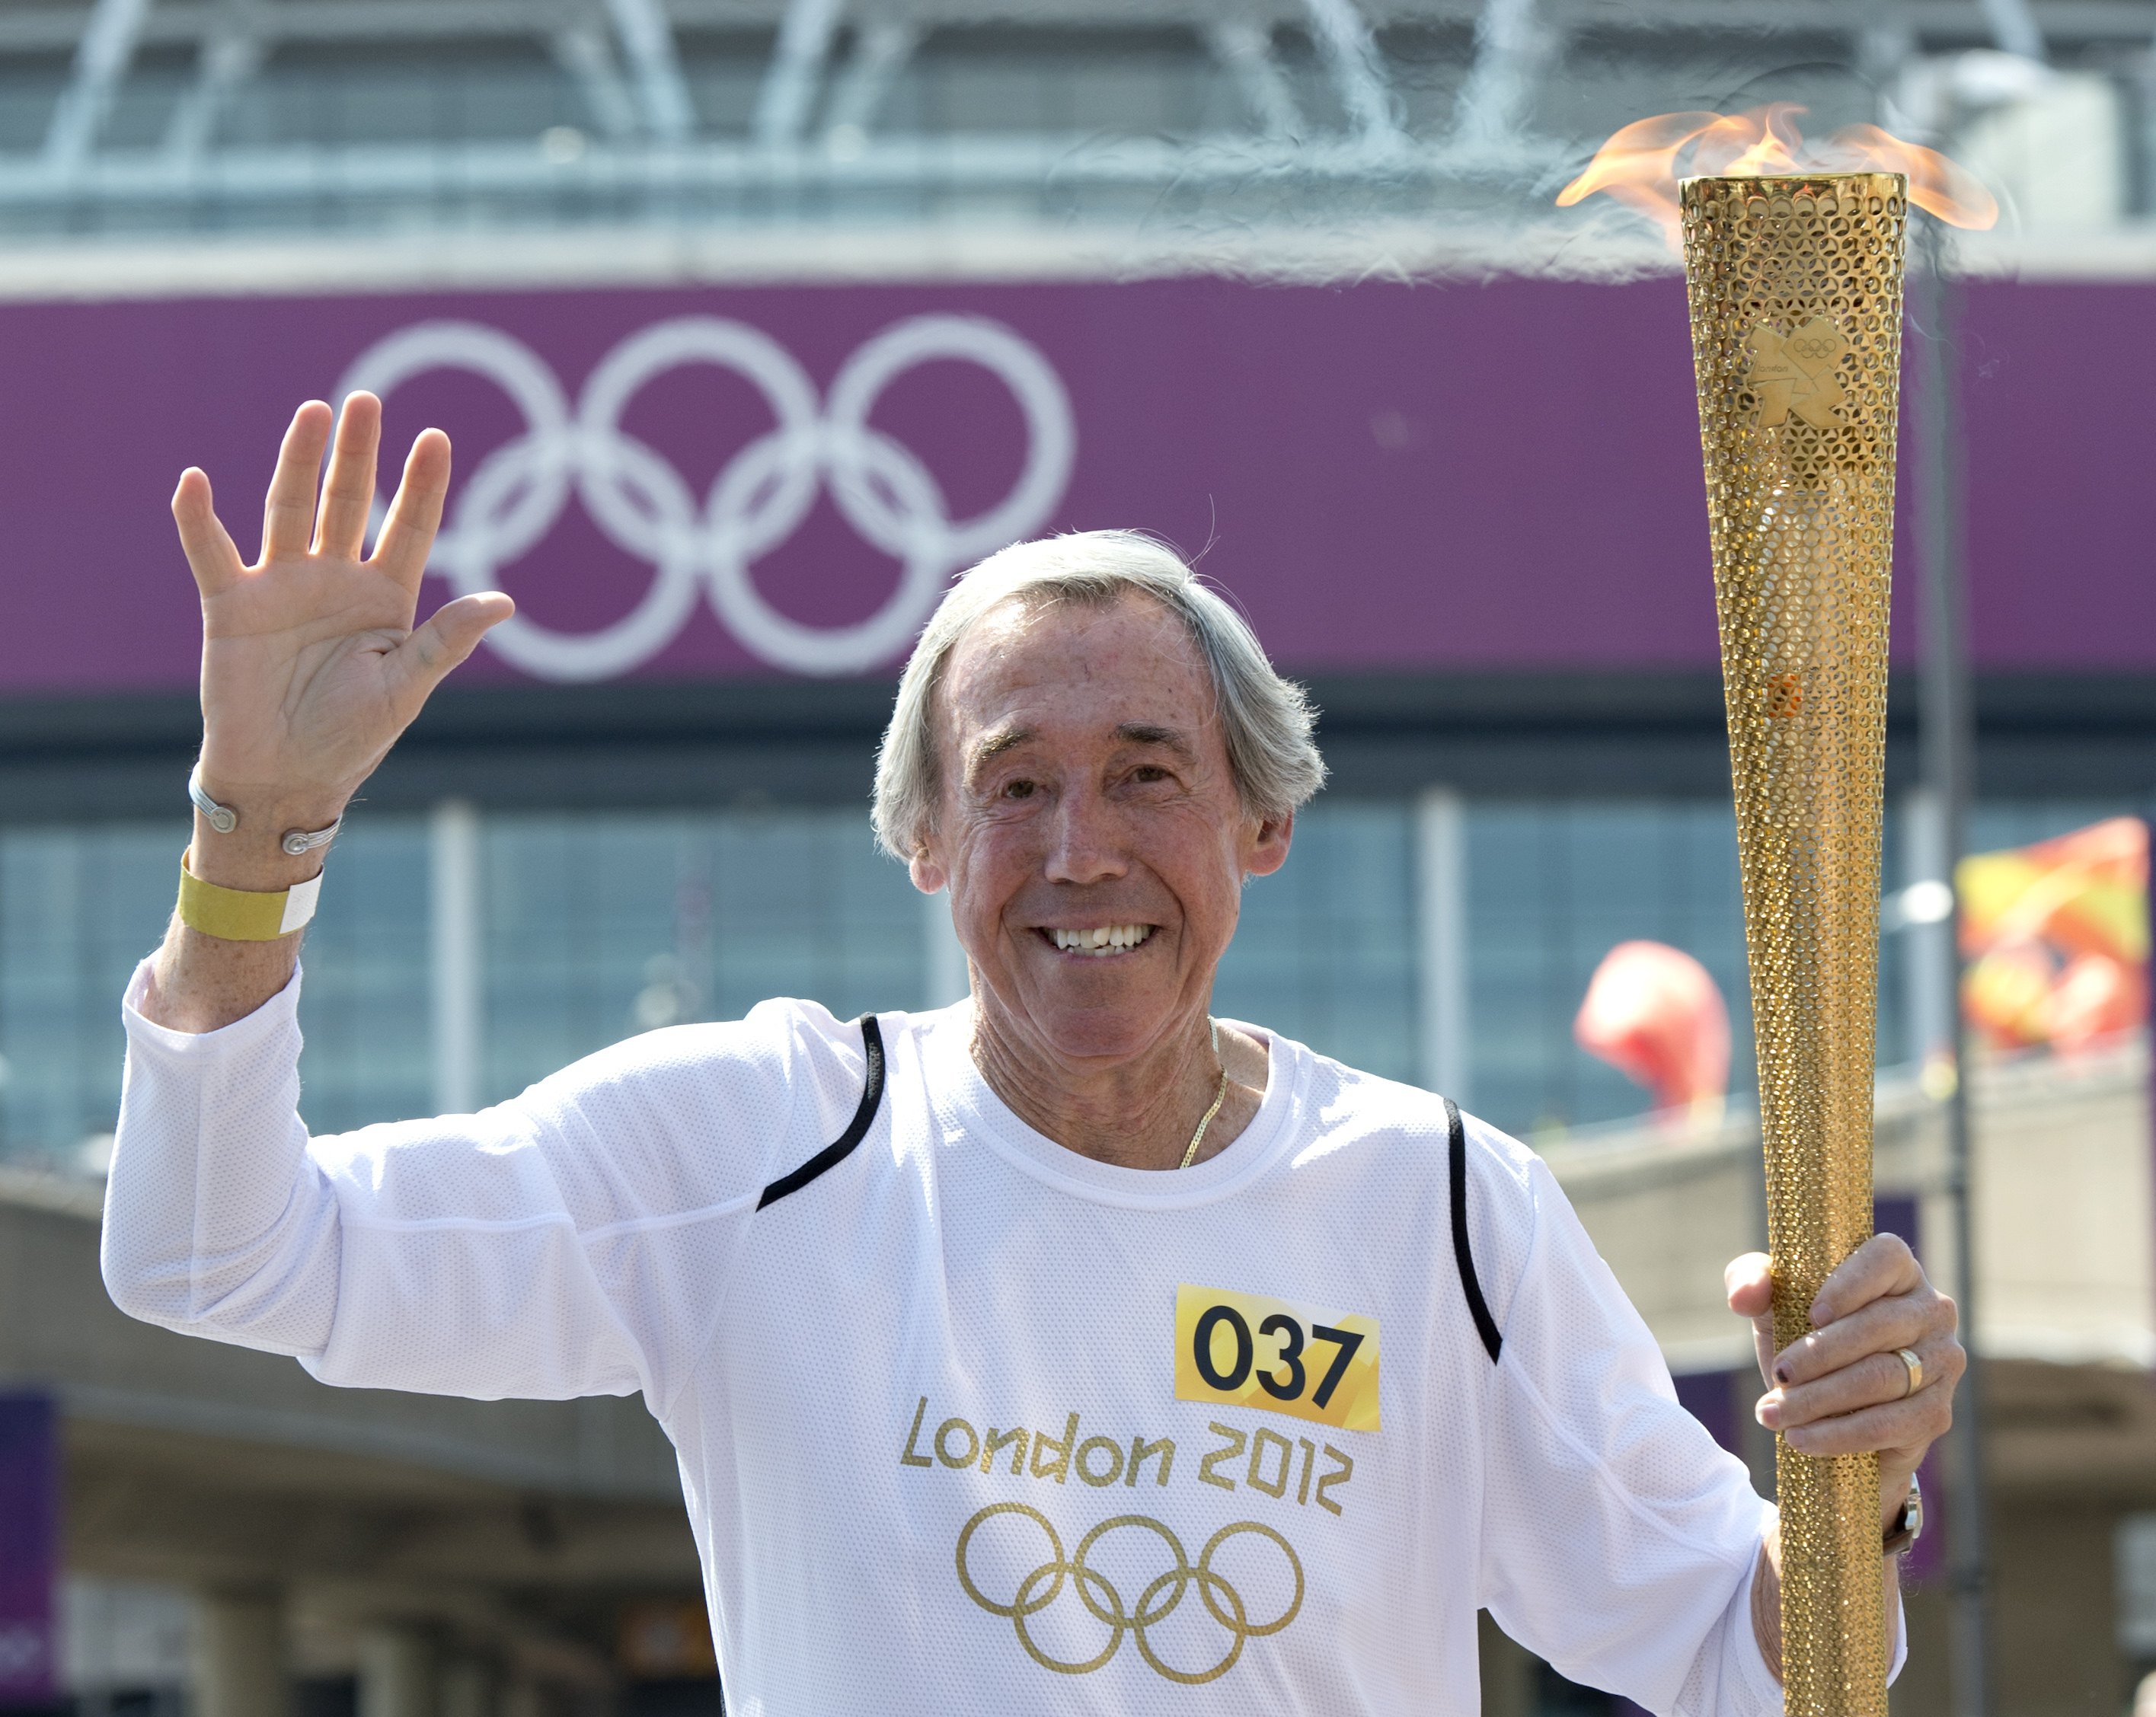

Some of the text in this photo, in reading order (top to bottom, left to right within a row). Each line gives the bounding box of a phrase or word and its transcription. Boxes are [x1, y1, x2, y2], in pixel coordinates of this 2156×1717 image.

[1193, 1305, 1365, 1409] 037
[900, 1396, 1354, 1517] London 2012
